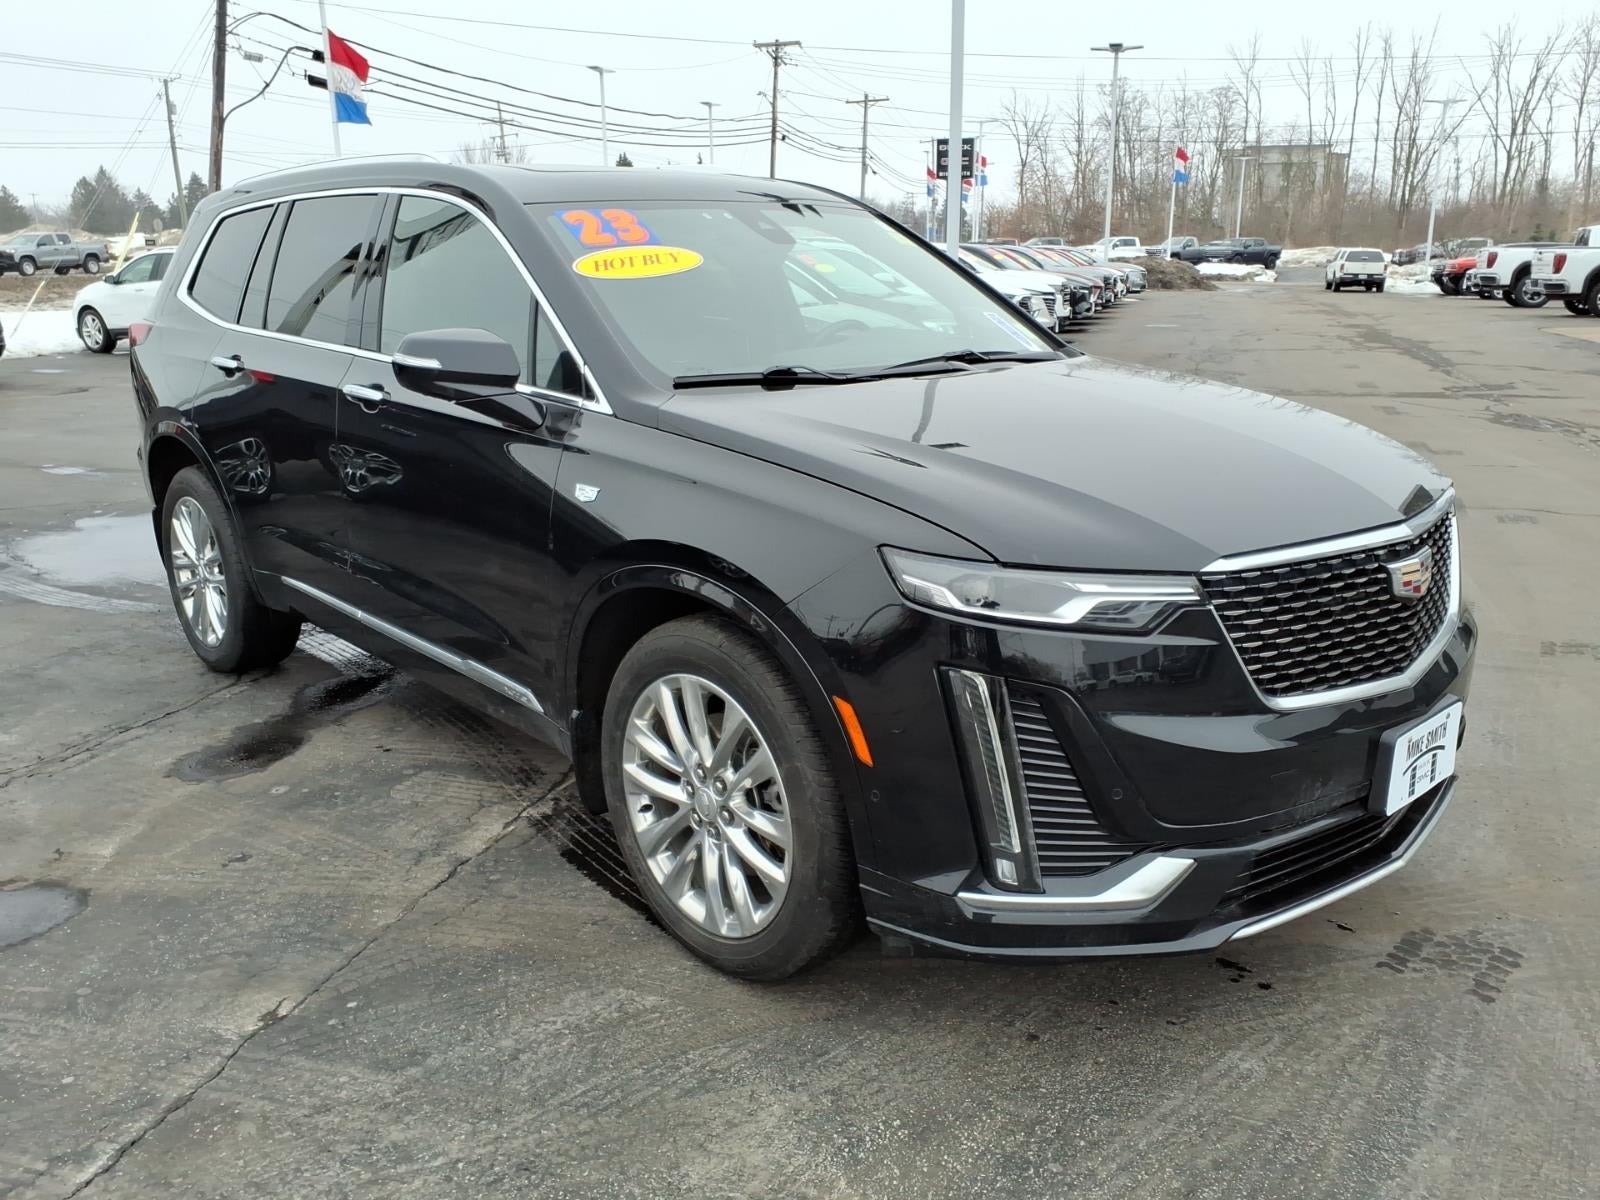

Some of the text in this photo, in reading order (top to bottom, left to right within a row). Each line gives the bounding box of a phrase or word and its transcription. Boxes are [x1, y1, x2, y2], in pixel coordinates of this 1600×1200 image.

[562, 208, 650, 246] 23
[594, 252, 681, 273] HOT BUY
[1406, 721, 1448, 761] MIKE SMITH
